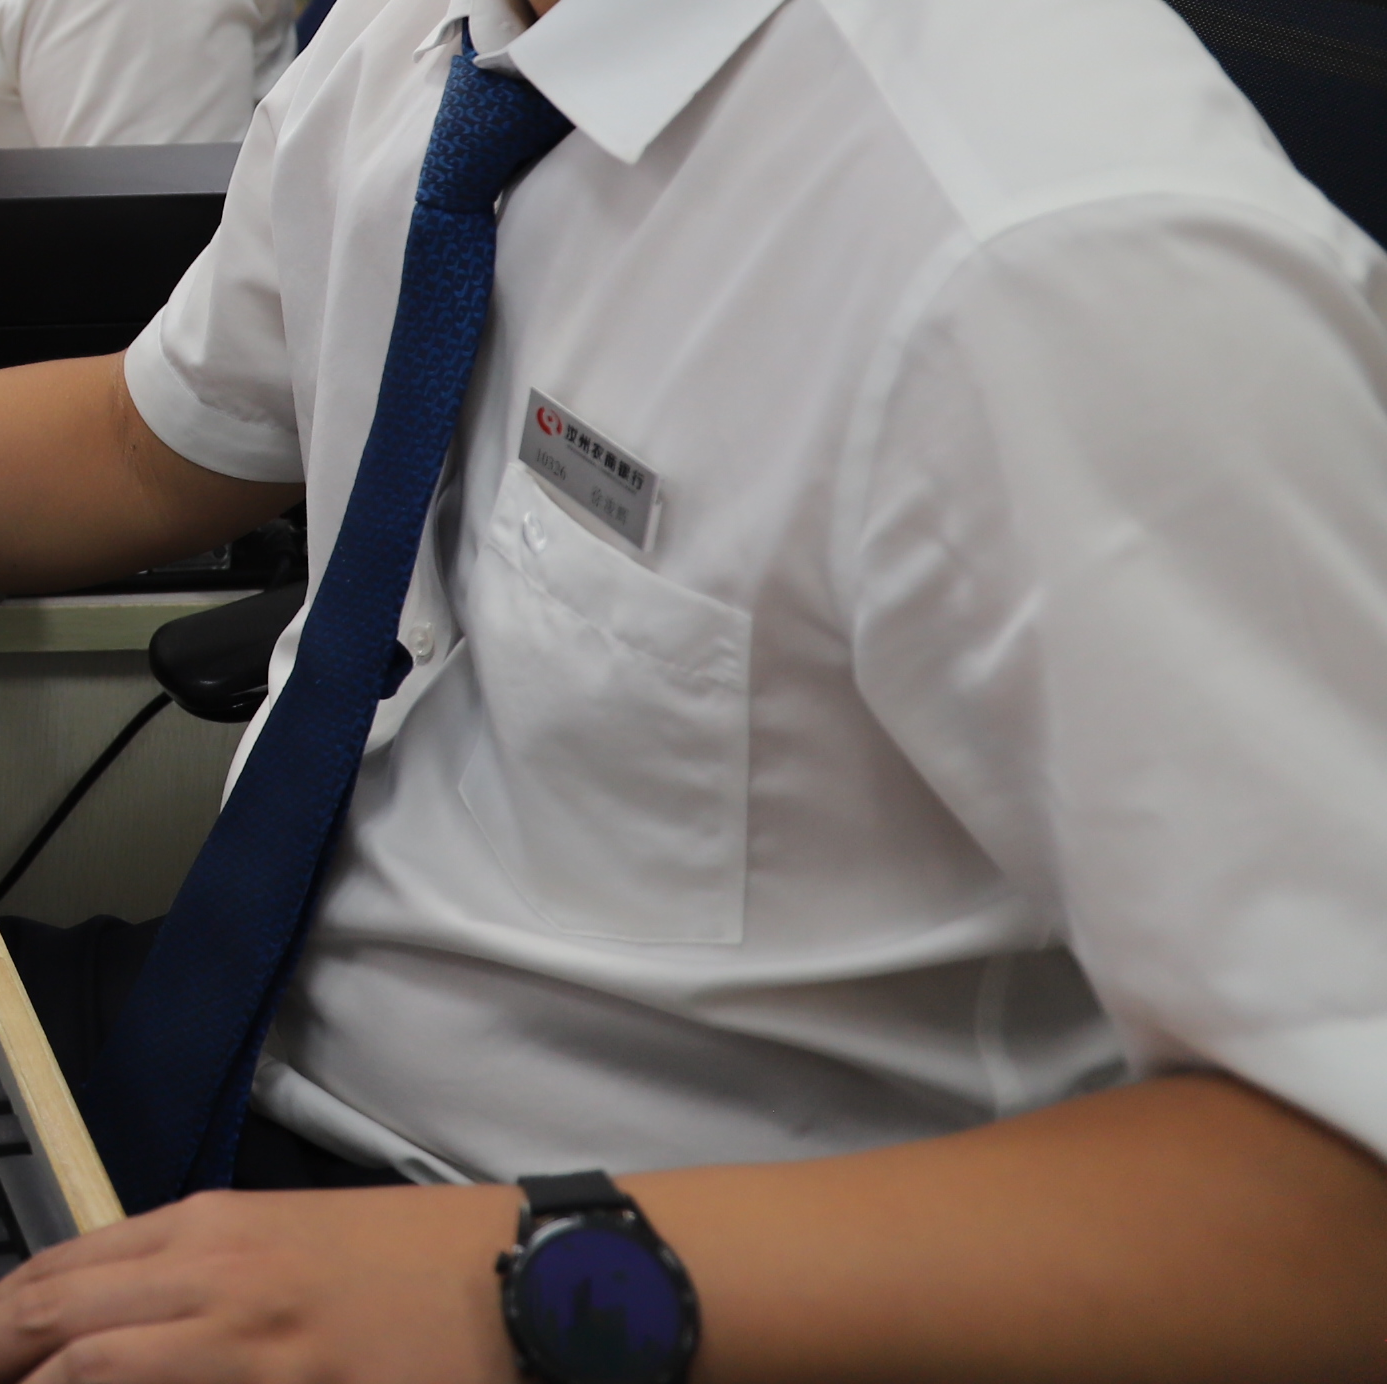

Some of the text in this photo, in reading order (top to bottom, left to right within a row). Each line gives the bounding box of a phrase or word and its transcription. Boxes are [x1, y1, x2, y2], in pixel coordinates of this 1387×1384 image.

[565, 424, 645, 491] 汝州农商银行
